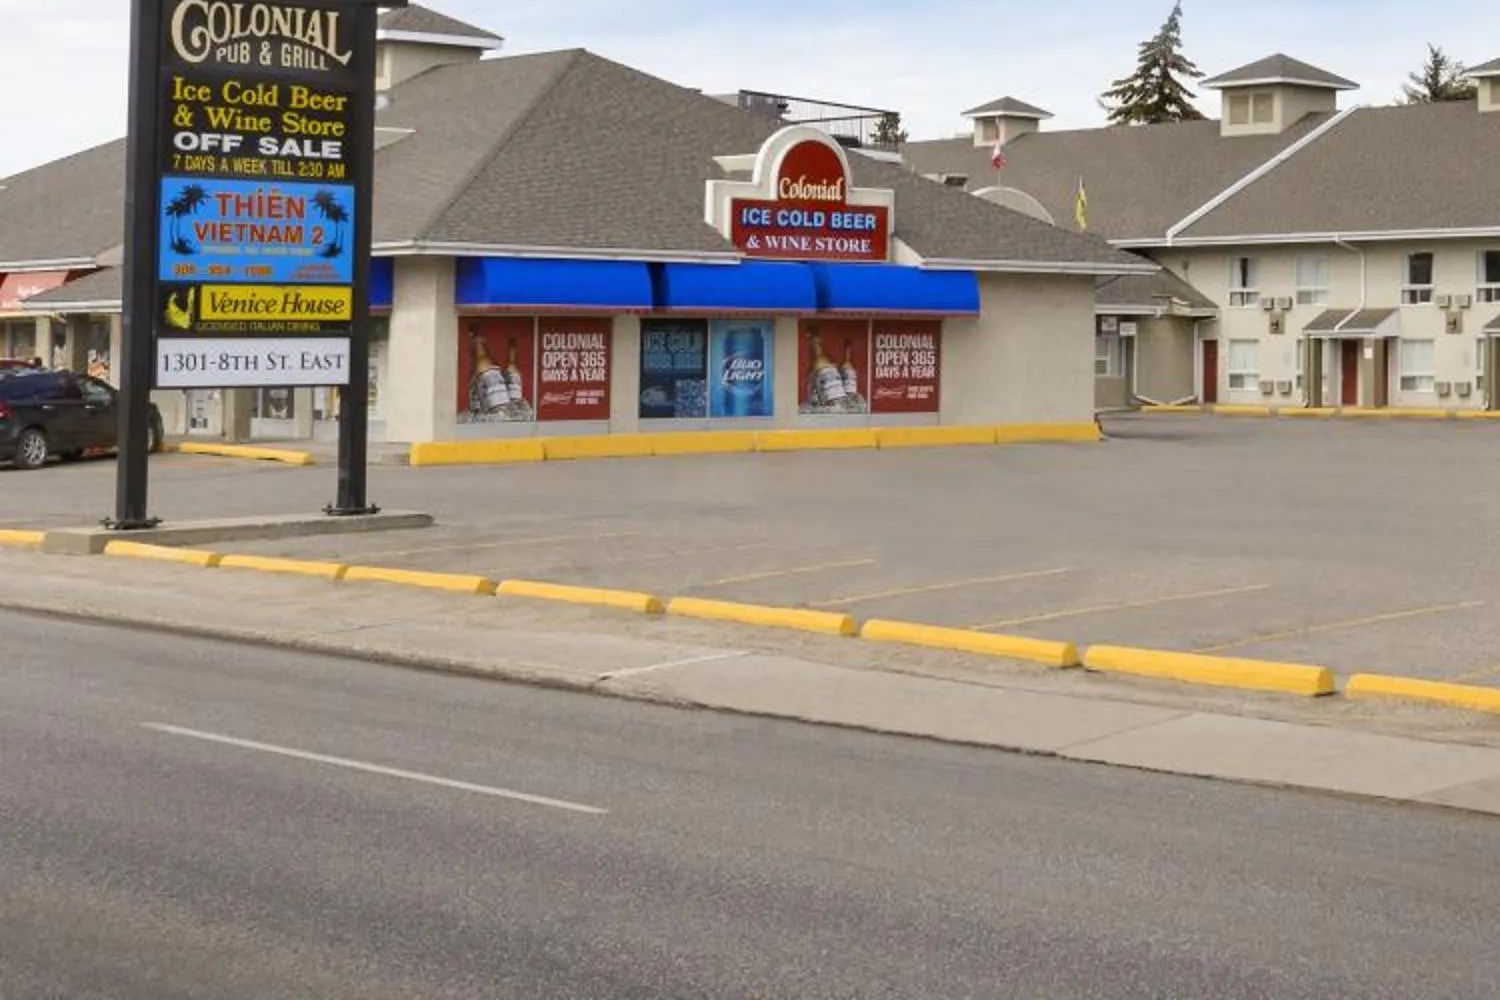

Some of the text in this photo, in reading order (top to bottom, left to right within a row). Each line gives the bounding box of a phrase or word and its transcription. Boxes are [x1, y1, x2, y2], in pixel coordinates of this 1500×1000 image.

[216, 41, 329, 71] PUB & GRILL
[172, 76, 347, 111] Ice Cold Beer
[173, 104, 345, 136] & Wine Store
[173, 131, 343, 159] OFF SALE
[173, 154, 346, 179] 7 DAYS A WEEK TILL 2:30 AM
[779, 175, 844, 201] Colonial
[742, 208, 876, 229] ICE COLD BEER
[194, 222, 325, 245] VIETNAM 2
[747, 235, 871, 253] & WINE STORE
[210, 291, 345, 315] Venice House
[543, 333, 606, 349] COLONIAL
[875, 333, 935, 349] COLONIAL
[543, 351, 605, 368] OPEN 365
[731, 359, 762, 369] BUD
[876, 350, 935, 366] OPEN 365
[542, 368, 605, 382] DAYS A YEAR
[721, 369, 765, 385] LIGHT
[875, 366, 935, 379] DAYS A YEAR
